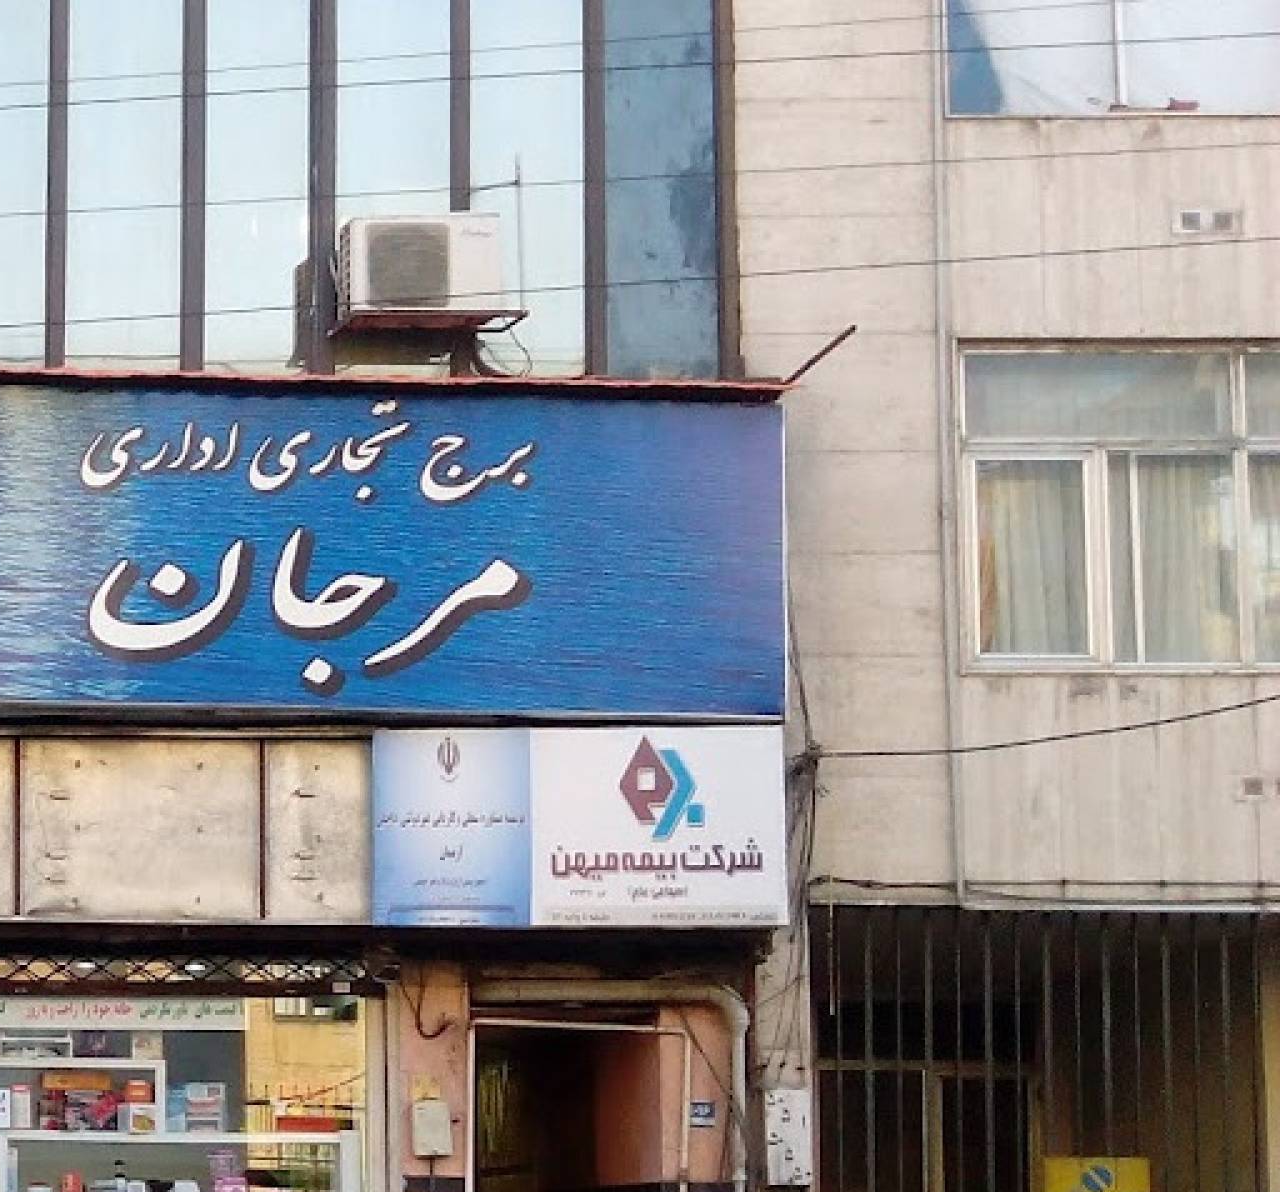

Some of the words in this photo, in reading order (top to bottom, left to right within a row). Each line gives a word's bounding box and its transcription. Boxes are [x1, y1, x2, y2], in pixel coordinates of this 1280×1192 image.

[82, 423, 237, 487] اداری
[249, 402, 408, 499] تجاری
[420, 432, 534, 501] برج
[88, 527, 522, 684] مرجان
[551, 845, 619, 881] میهن
[622, 850, 676, 881] بیمه
[680, 838, 763, 877] شرکت
